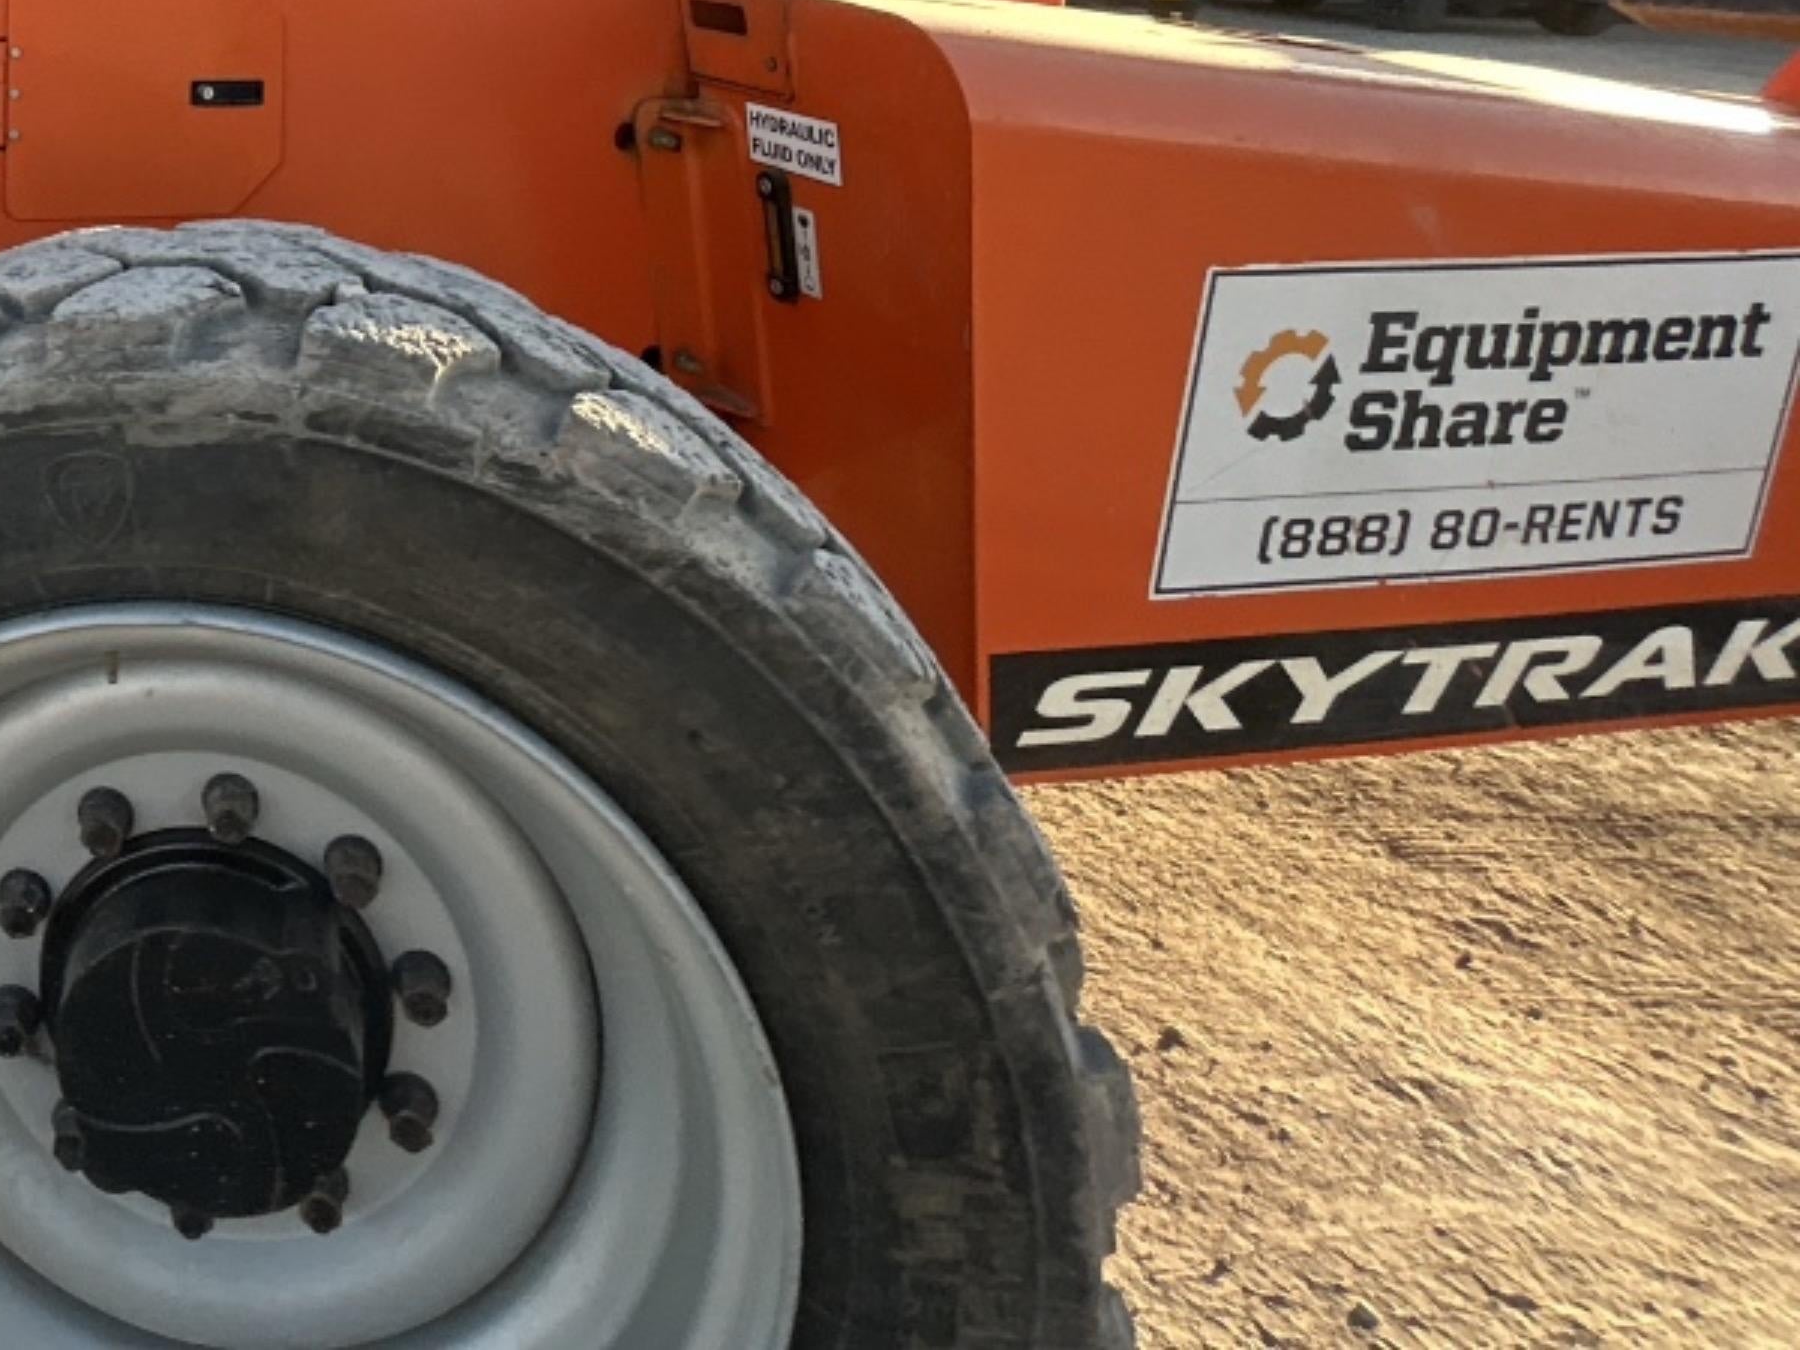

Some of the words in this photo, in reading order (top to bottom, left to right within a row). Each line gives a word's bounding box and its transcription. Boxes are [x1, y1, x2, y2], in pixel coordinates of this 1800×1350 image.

[750, 111, 835, 148] HYDRAULIC
[753, 137, 792, 162] FLUID
[797, 149, 836, 175] ONLY
[1360, 303, 1771, 385] Equipment
[1344, 391, 1568, 452] Share
[1257, 510, 1411, 565] (888)
[1429, 496, 1684, 553] 80-RENTS
[1016, 618, 1800, 748] SKYTRAK
